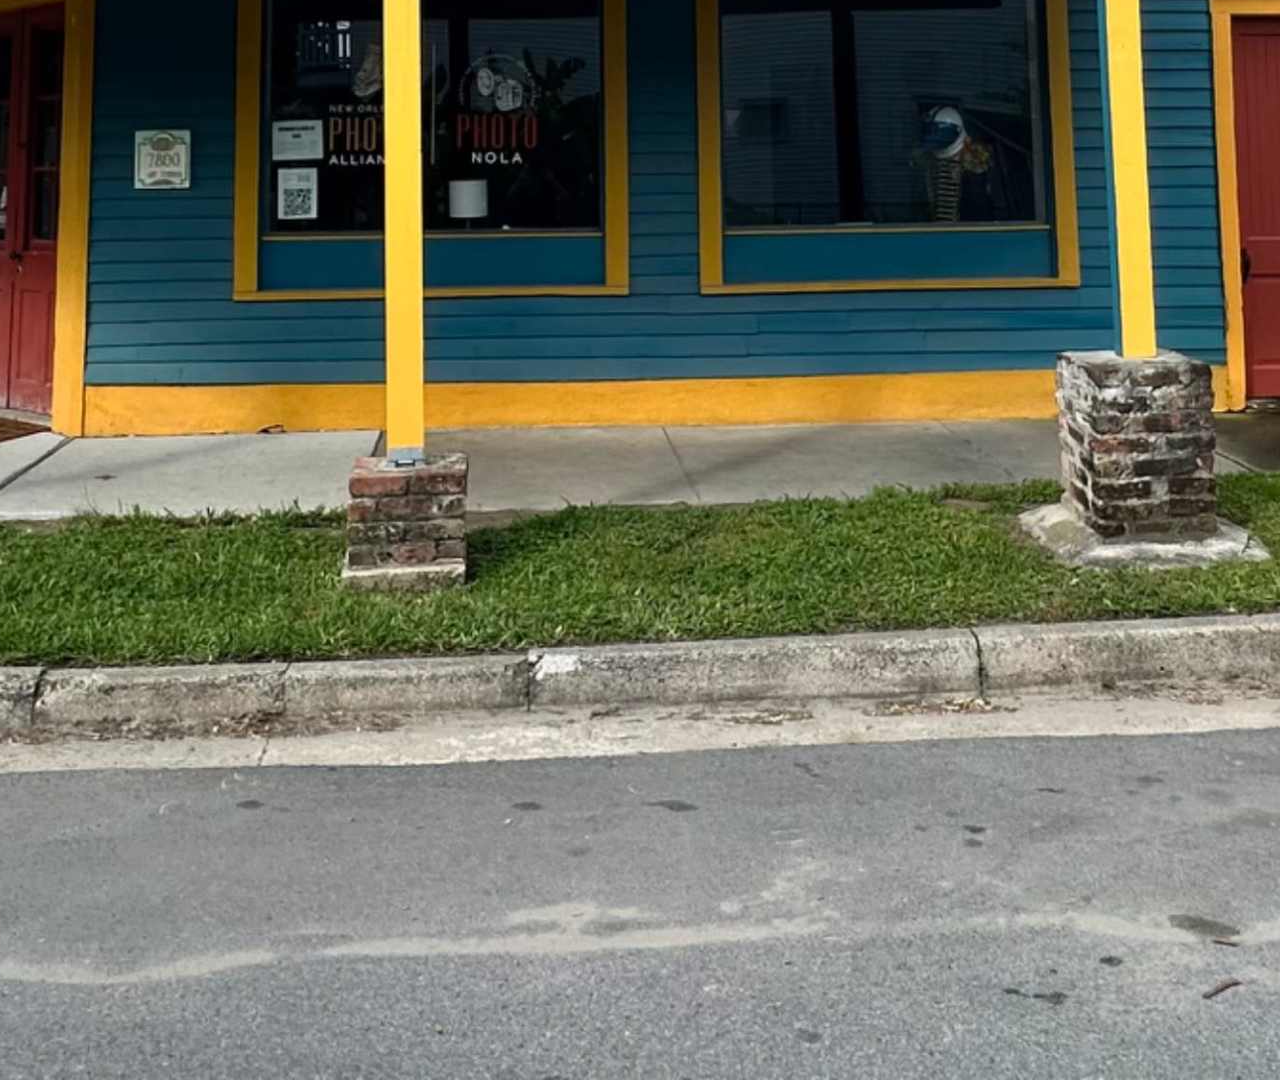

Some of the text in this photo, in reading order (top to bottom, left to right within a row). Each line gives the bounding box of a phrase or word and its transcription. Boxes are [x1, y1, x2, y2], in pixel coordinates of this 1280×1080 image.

[328, 104, 353, 113] NEW
[328, 116, 384, 152] PHO
[456, 113, 538, 149] PHOTO
[471, 152, 523, 164] NOLA
